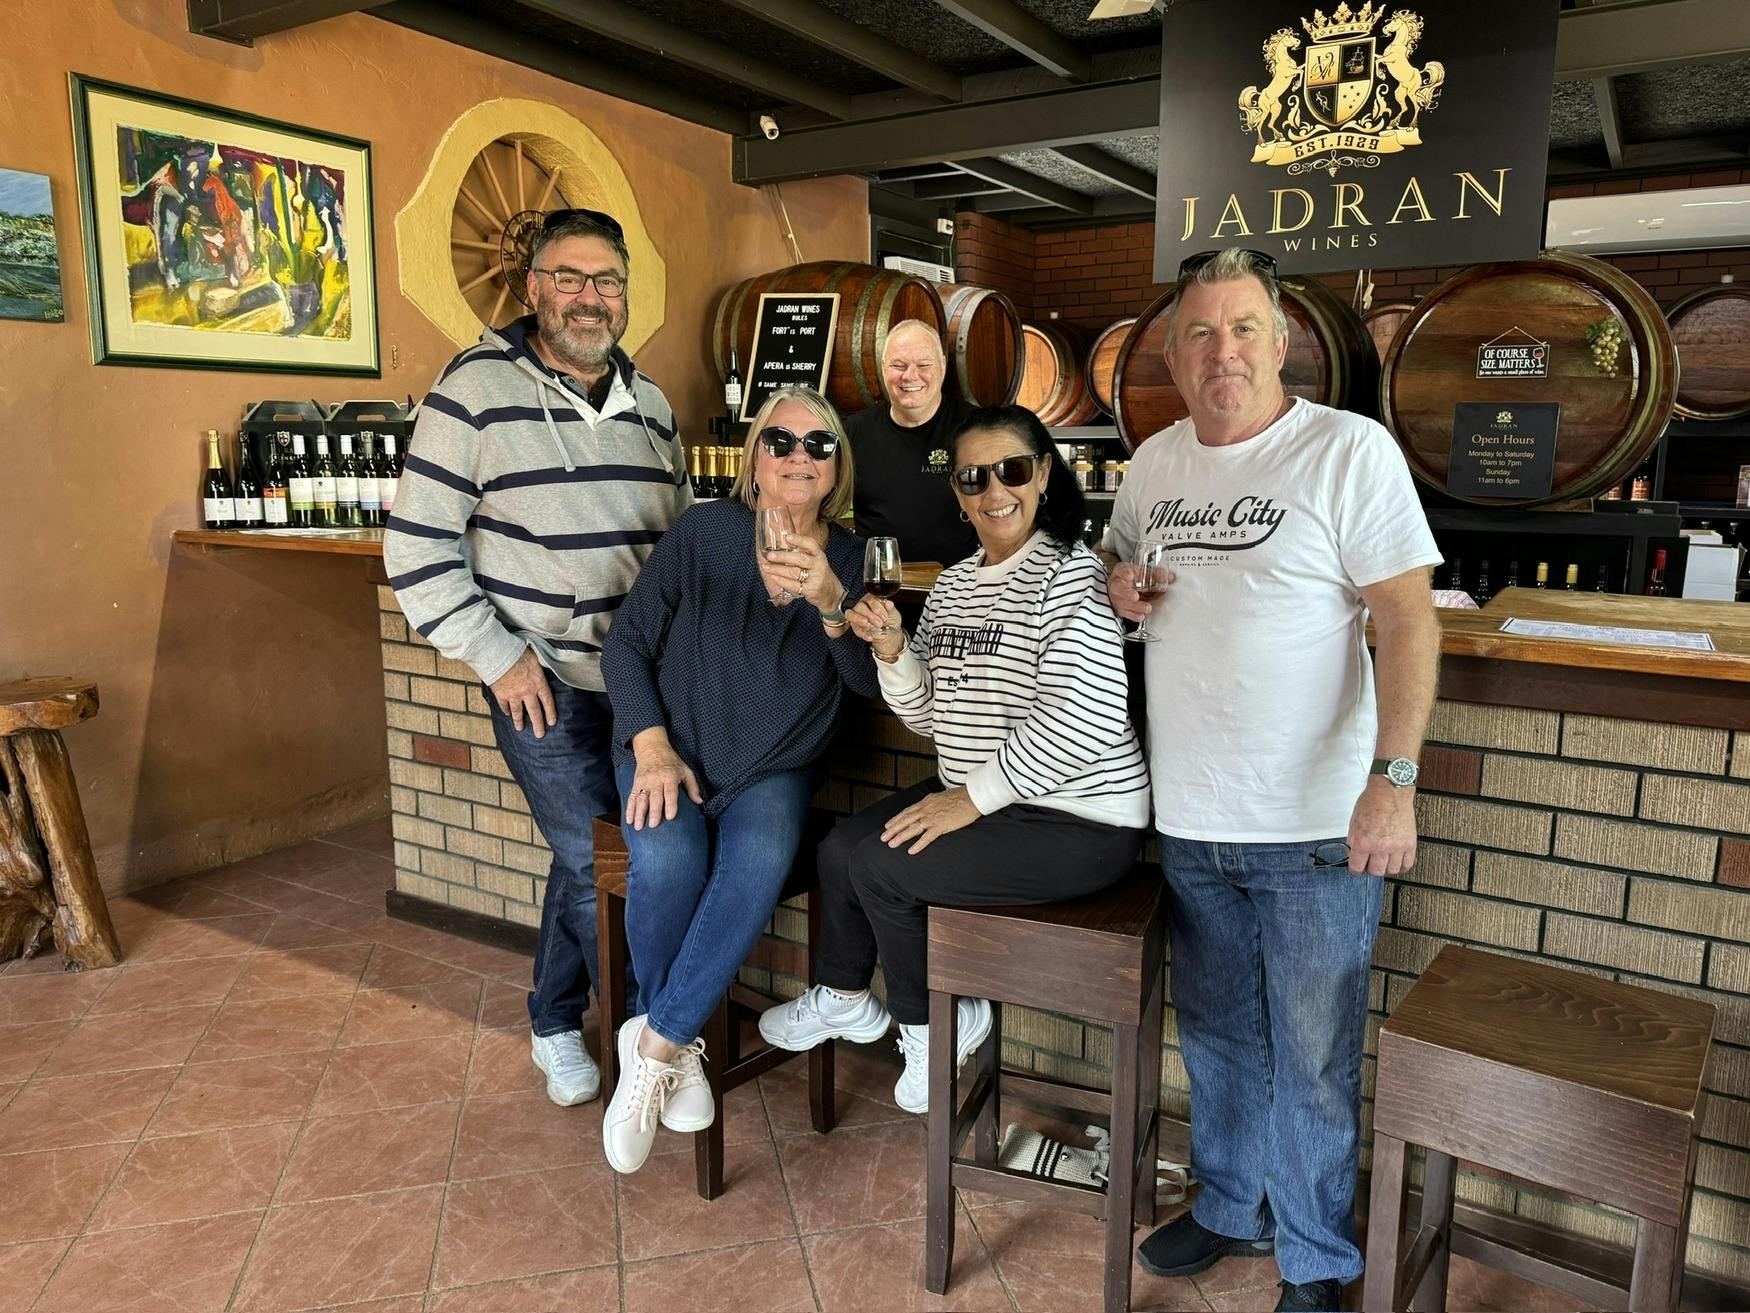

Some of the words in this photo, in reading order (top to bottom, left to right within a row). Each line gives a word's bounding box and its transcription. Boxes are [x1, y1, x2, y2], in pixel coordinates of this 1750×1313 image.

[1180, 168, 1513, 242] JADRAN
[1283, 232, 1379, 252] WINES
[776, 305, 799, 313] JADRAN
[801, 305, 820, 313] WINES
[799, 327, 816, 335] PORT
[788, 345, 794, 353] &
[1484, 349, 1495, 359] OF
[1496, 348, 1529, 358] COURSE
[763, 362, 784, 370] APERA
[1480, 359, 1496, 369] SIZE
[1498, 358, 1535, 368] MATTERS
[1471, 434, 1500, 446] Open
[1503, 434, 1536, 445] Hours
[1468, 450, 1495, 458] Monday
[1504, 451, 1535, 459] Saturday
[1507, 459, 1522, 467] 7pm
[1485, 468, 1511, 476] Sunday
[1504, 477, 1520, 485] 6pm
[1145, 498, 1223, 535] Music
[1161, 532, 1203, 541] VALVE
[1210, 531, 1247, 539] AMPS
